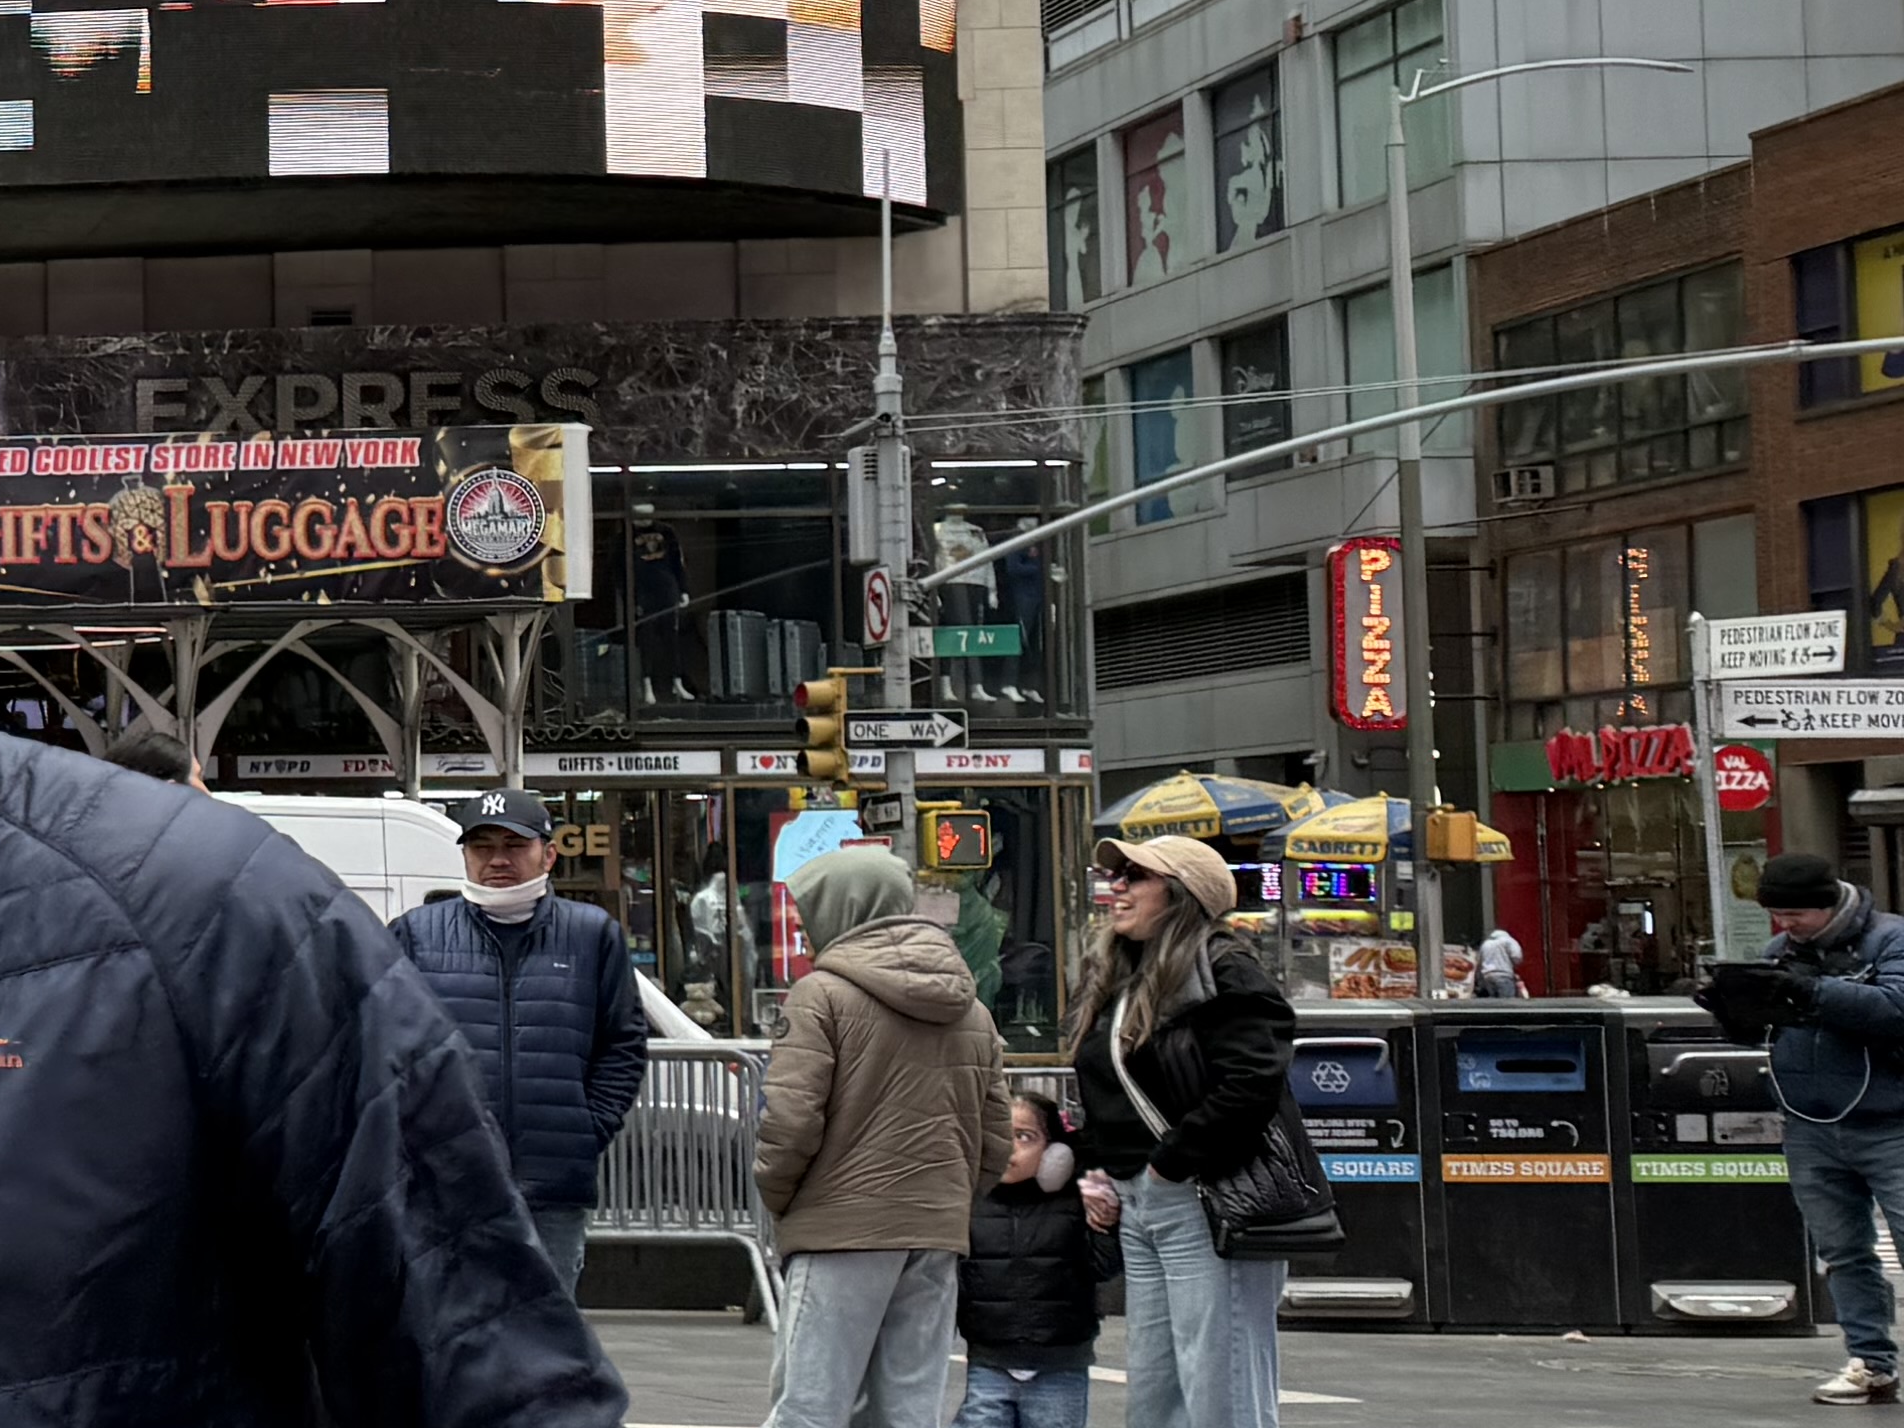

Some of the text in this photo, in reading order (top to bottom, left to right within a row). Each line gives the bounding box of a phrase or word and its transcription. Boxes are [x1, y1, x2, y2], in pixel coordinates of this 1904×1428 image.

[136, 369, 600, 434] EXPRESS
[32, 445, 144, 473] COOLEST
[152, 443, 234, 472] STORE
[240, 442, 275, 470] IN
[279, 440, 340, 469] NEW
[346, 438, 422, 467] YORK
[131, 524, 155, 552] &
[957, 630, 967, 652] 7
[1360, 548, 1393, 717] PIZZA
[1720, 619, 1840, 646] PEDESTRIAN FLOW ZONE
[1720, 648, 1786, 669] KEEP MOVING
[1734, 689, 1904, 706] PEDESTRIAN FLOW ZO
[1820, 713, 1864, 729] KEEP
[853, 723, 948, 738] ONE WAY
[1598, 723, 1695, 781] PIZZA
[618, 756, 680, 771] LUGGAGE
[1723, 756, 1750, 770] VAL
[1292, 840, 1380, 855] SABRETT
[1332, 1161, 1415, 1176] SQUARE
[1447, 1161, 1604, 1176] TIMES SQUARE
[1636, 1162, 1789, 1177] TIMES SQUAR
